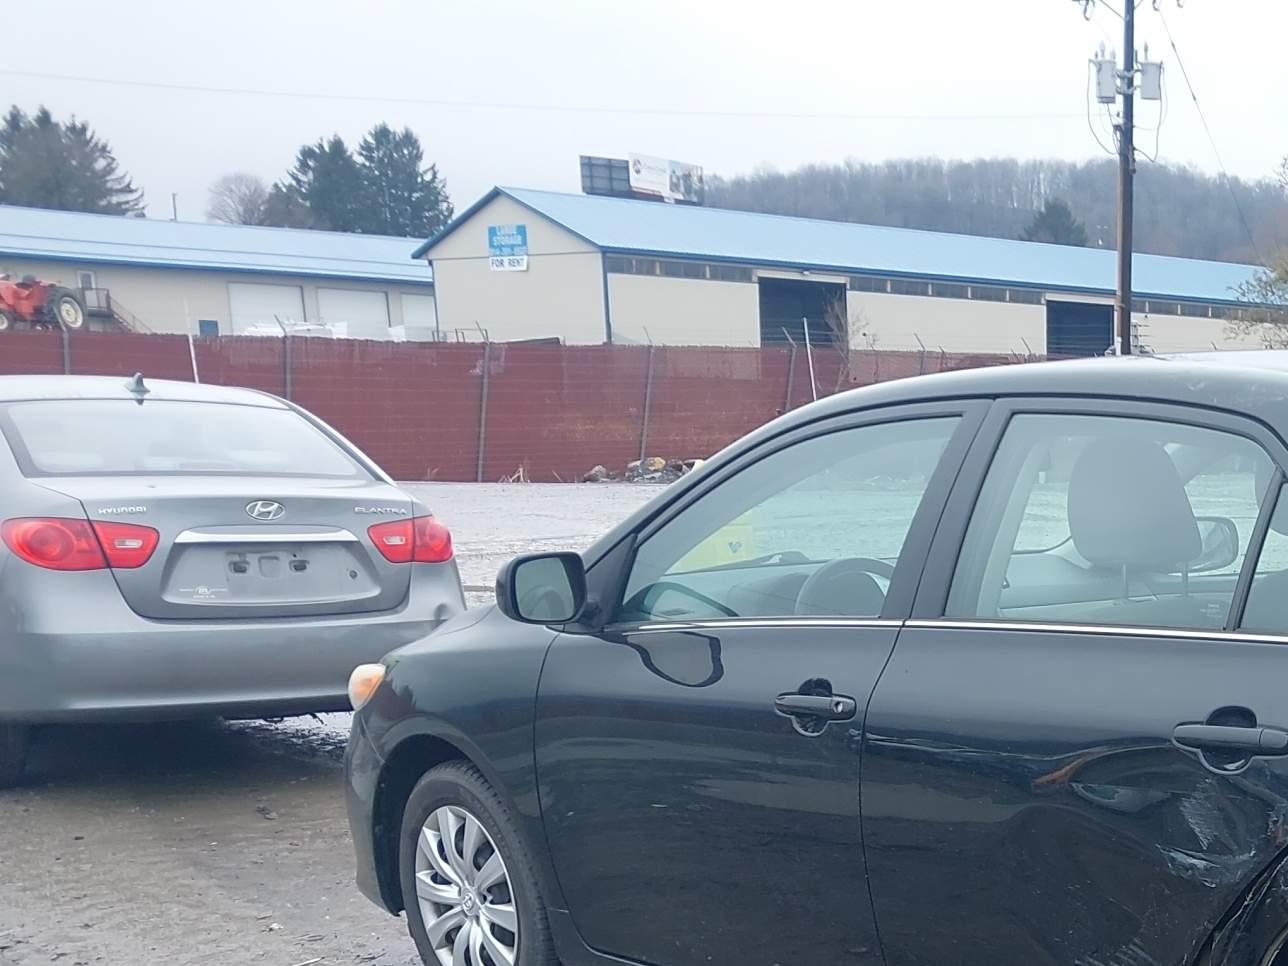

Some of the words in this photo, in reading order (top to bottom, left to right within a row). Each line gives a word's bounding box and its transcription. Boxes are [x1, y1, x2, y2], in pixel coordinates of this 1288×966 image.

[491, 258, 505, 268] FOR
[508, 258, 525, 268] RENT
[98, 505, 147, 515] HYUNDAI
[354, 506, 408, 515] ELANTRA
